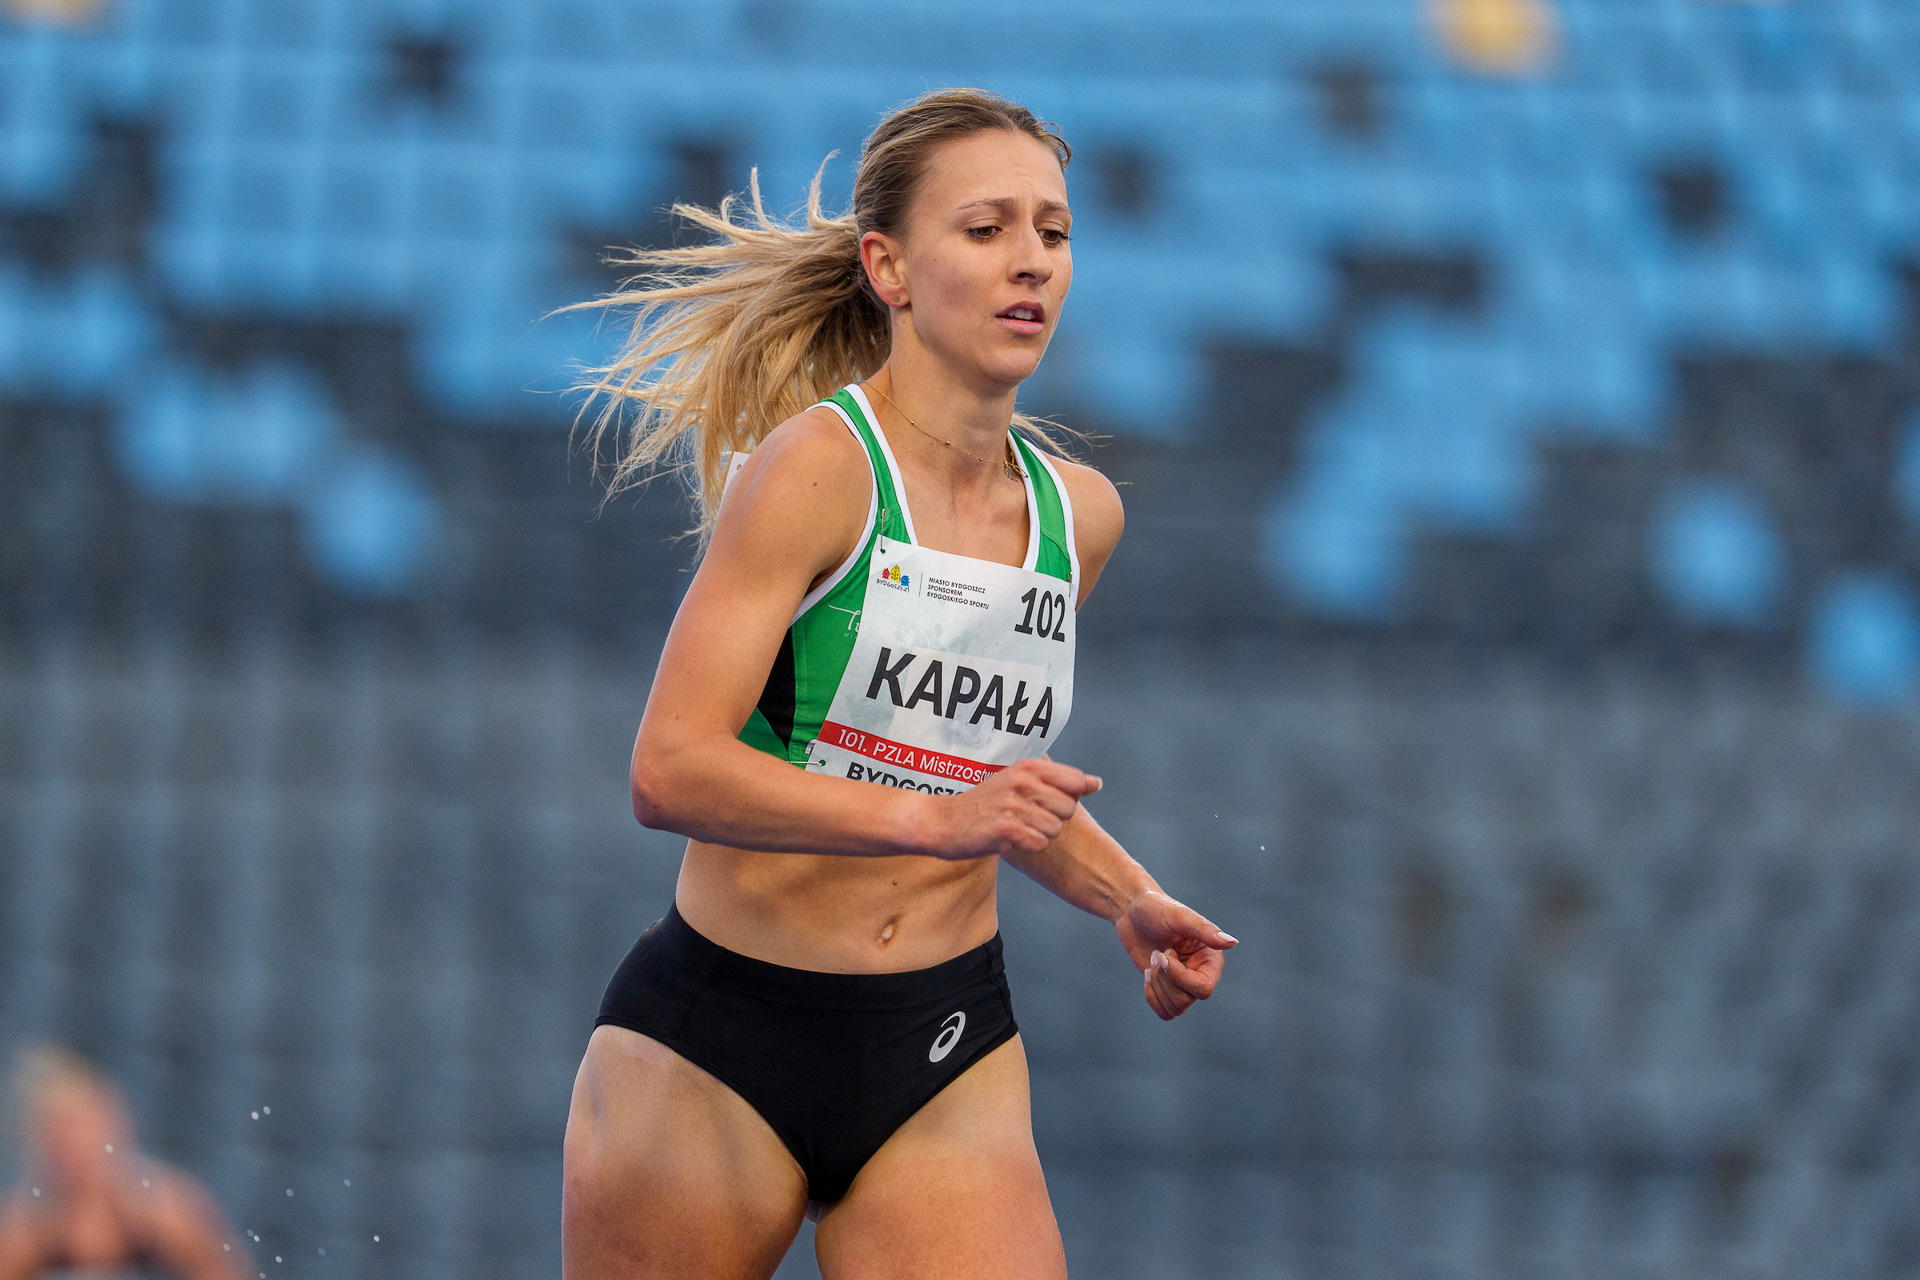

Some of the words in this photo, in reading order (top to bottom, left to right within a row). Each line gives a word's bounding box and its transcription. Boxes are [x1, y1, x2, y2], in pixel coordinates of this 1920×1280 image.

[927, 584, 963, 596] SPONSOREM
[928, 577, 950, 587] MIASTO
[951, 581, 986, 594] BYDGOSZCZ
[926, 591, 969, 605] BYDGOSKIEGO
[969, 600, 990, 610] SPORTU
[1014, 587, 1066, 643] 102
[865, 646, 1054, 739] KAPAŁA
[837, 729, 867, 753] 101.
[872, 741, 915, 767] PZLA
